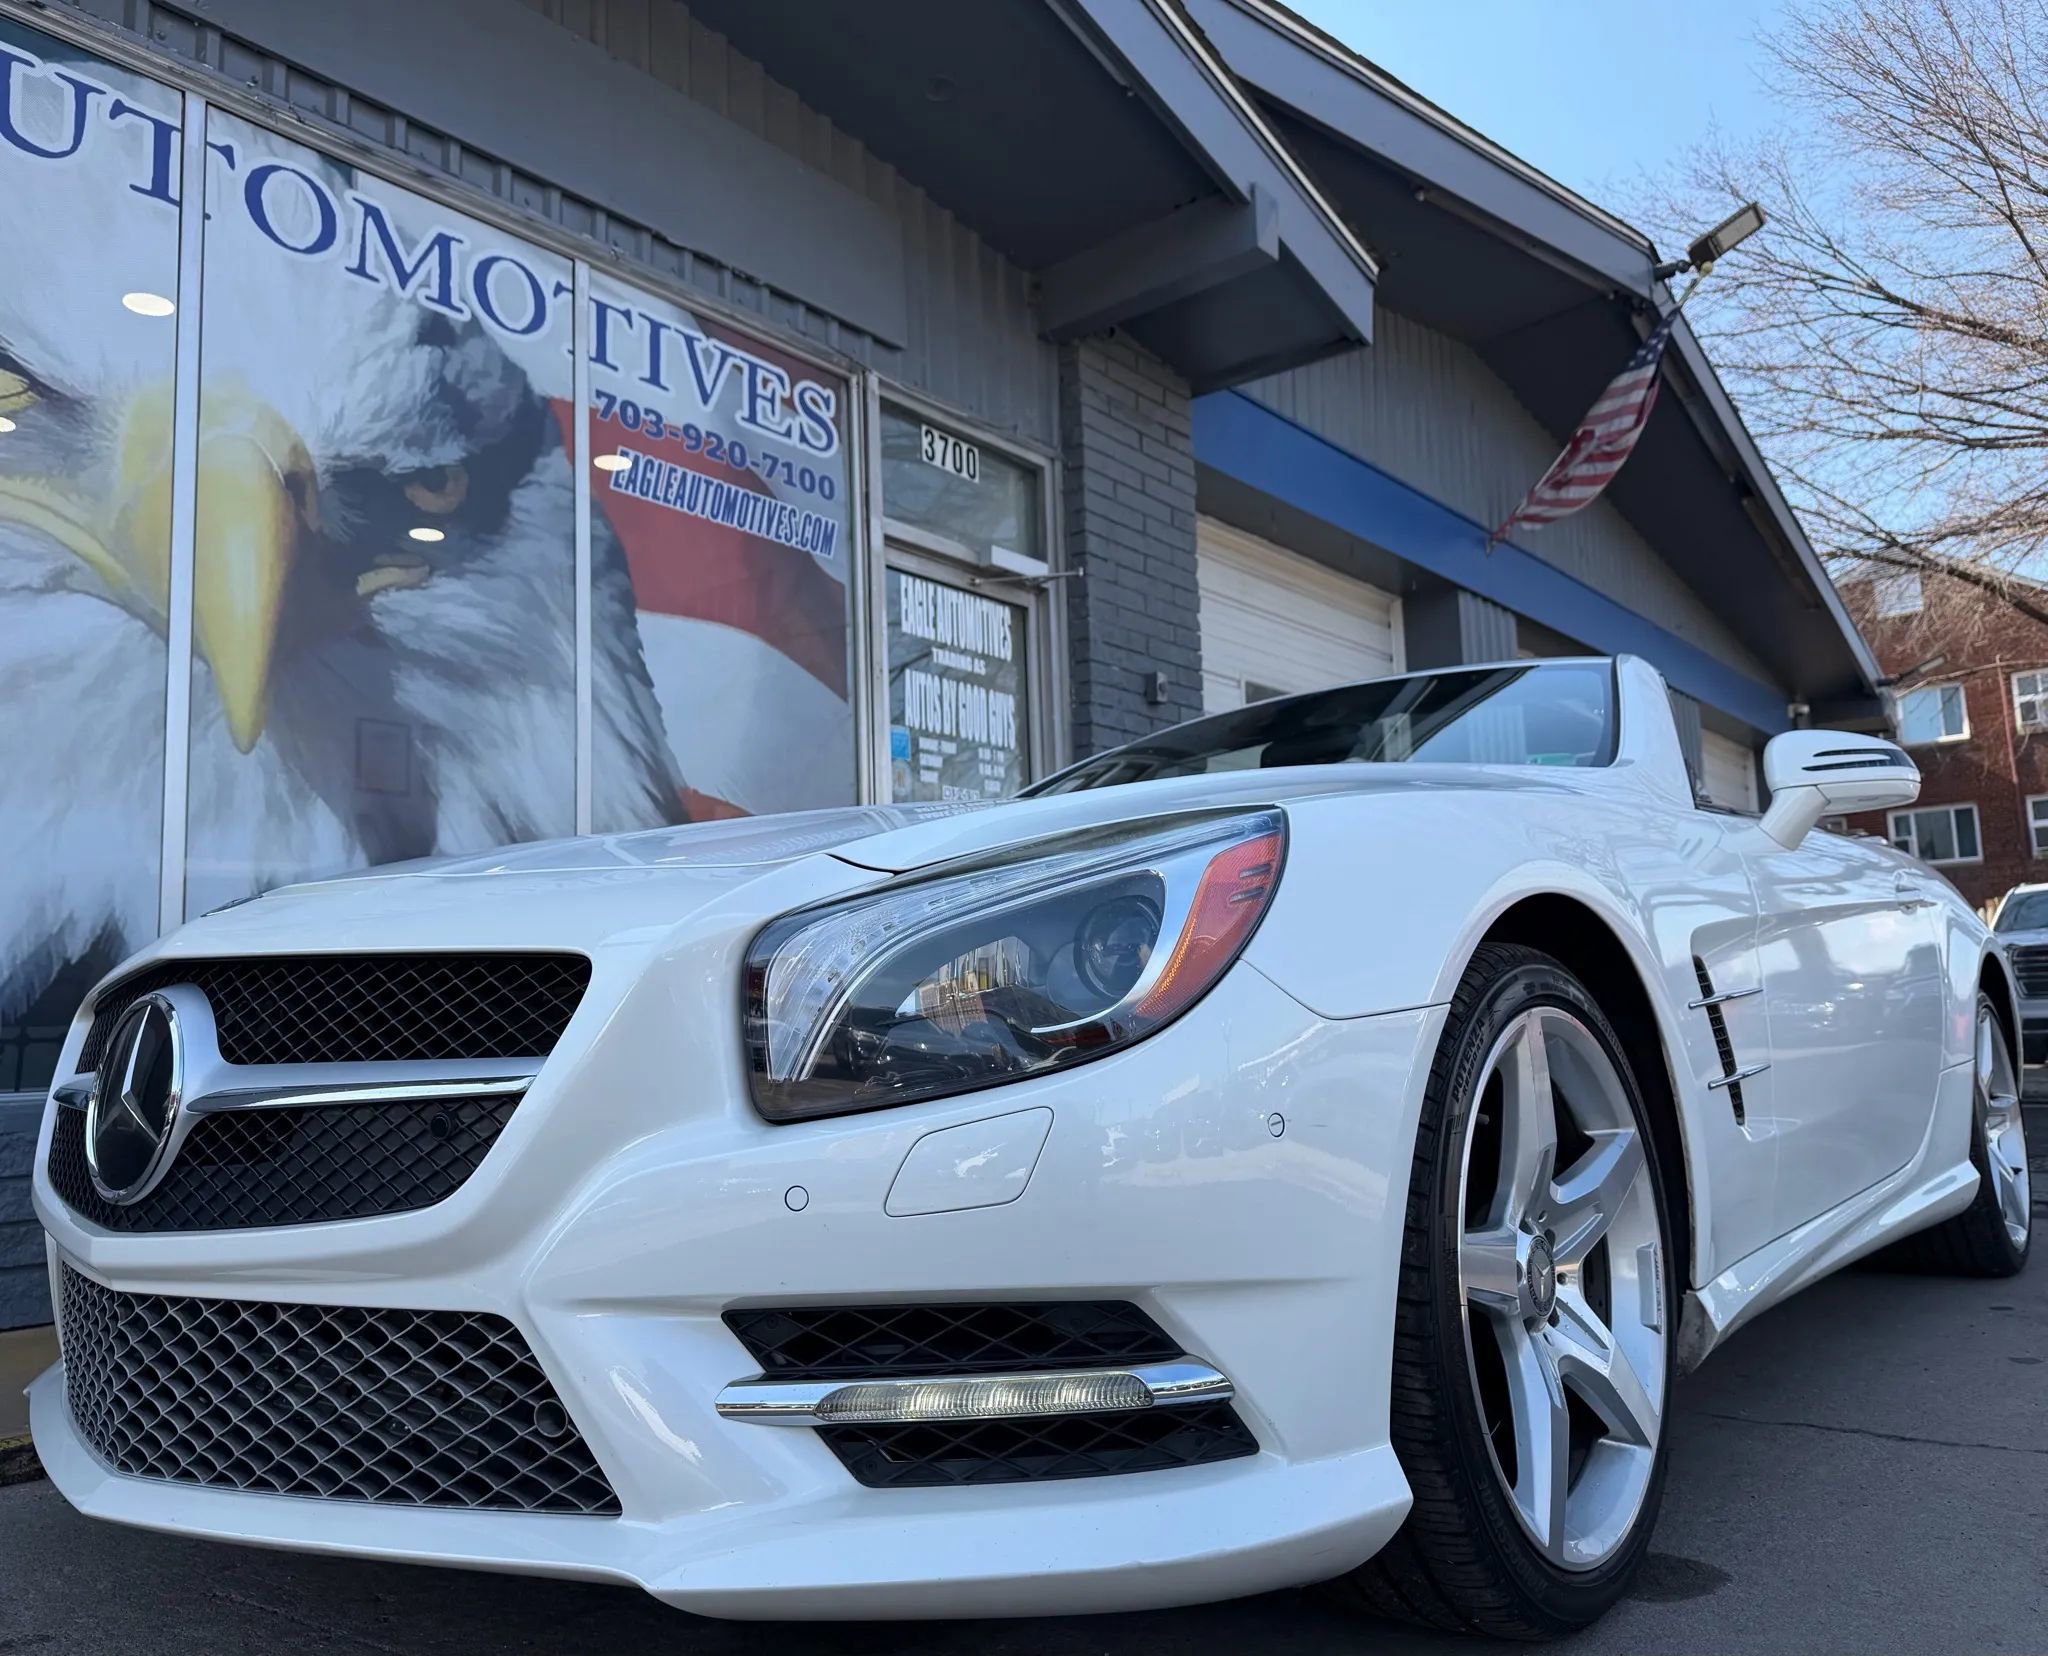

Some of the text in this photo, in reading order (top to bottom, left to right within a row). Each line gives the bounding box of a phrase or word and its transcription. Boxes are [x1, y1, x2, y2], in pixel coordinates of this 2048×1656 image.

[596, 390, 835, 500] 703-920-7100
[925, 430, 976, 479] 3700
[612, 449, 836, 555] EAGLEAUTOMOTIVES.COM
[900, 574, 1012, 662] EAGLE AUTOMOTIVES
[905, 668, 1016, 750] AUTOS BY GOOD GUYS
[1452, 1016, 1486, 1103] POTENZA
